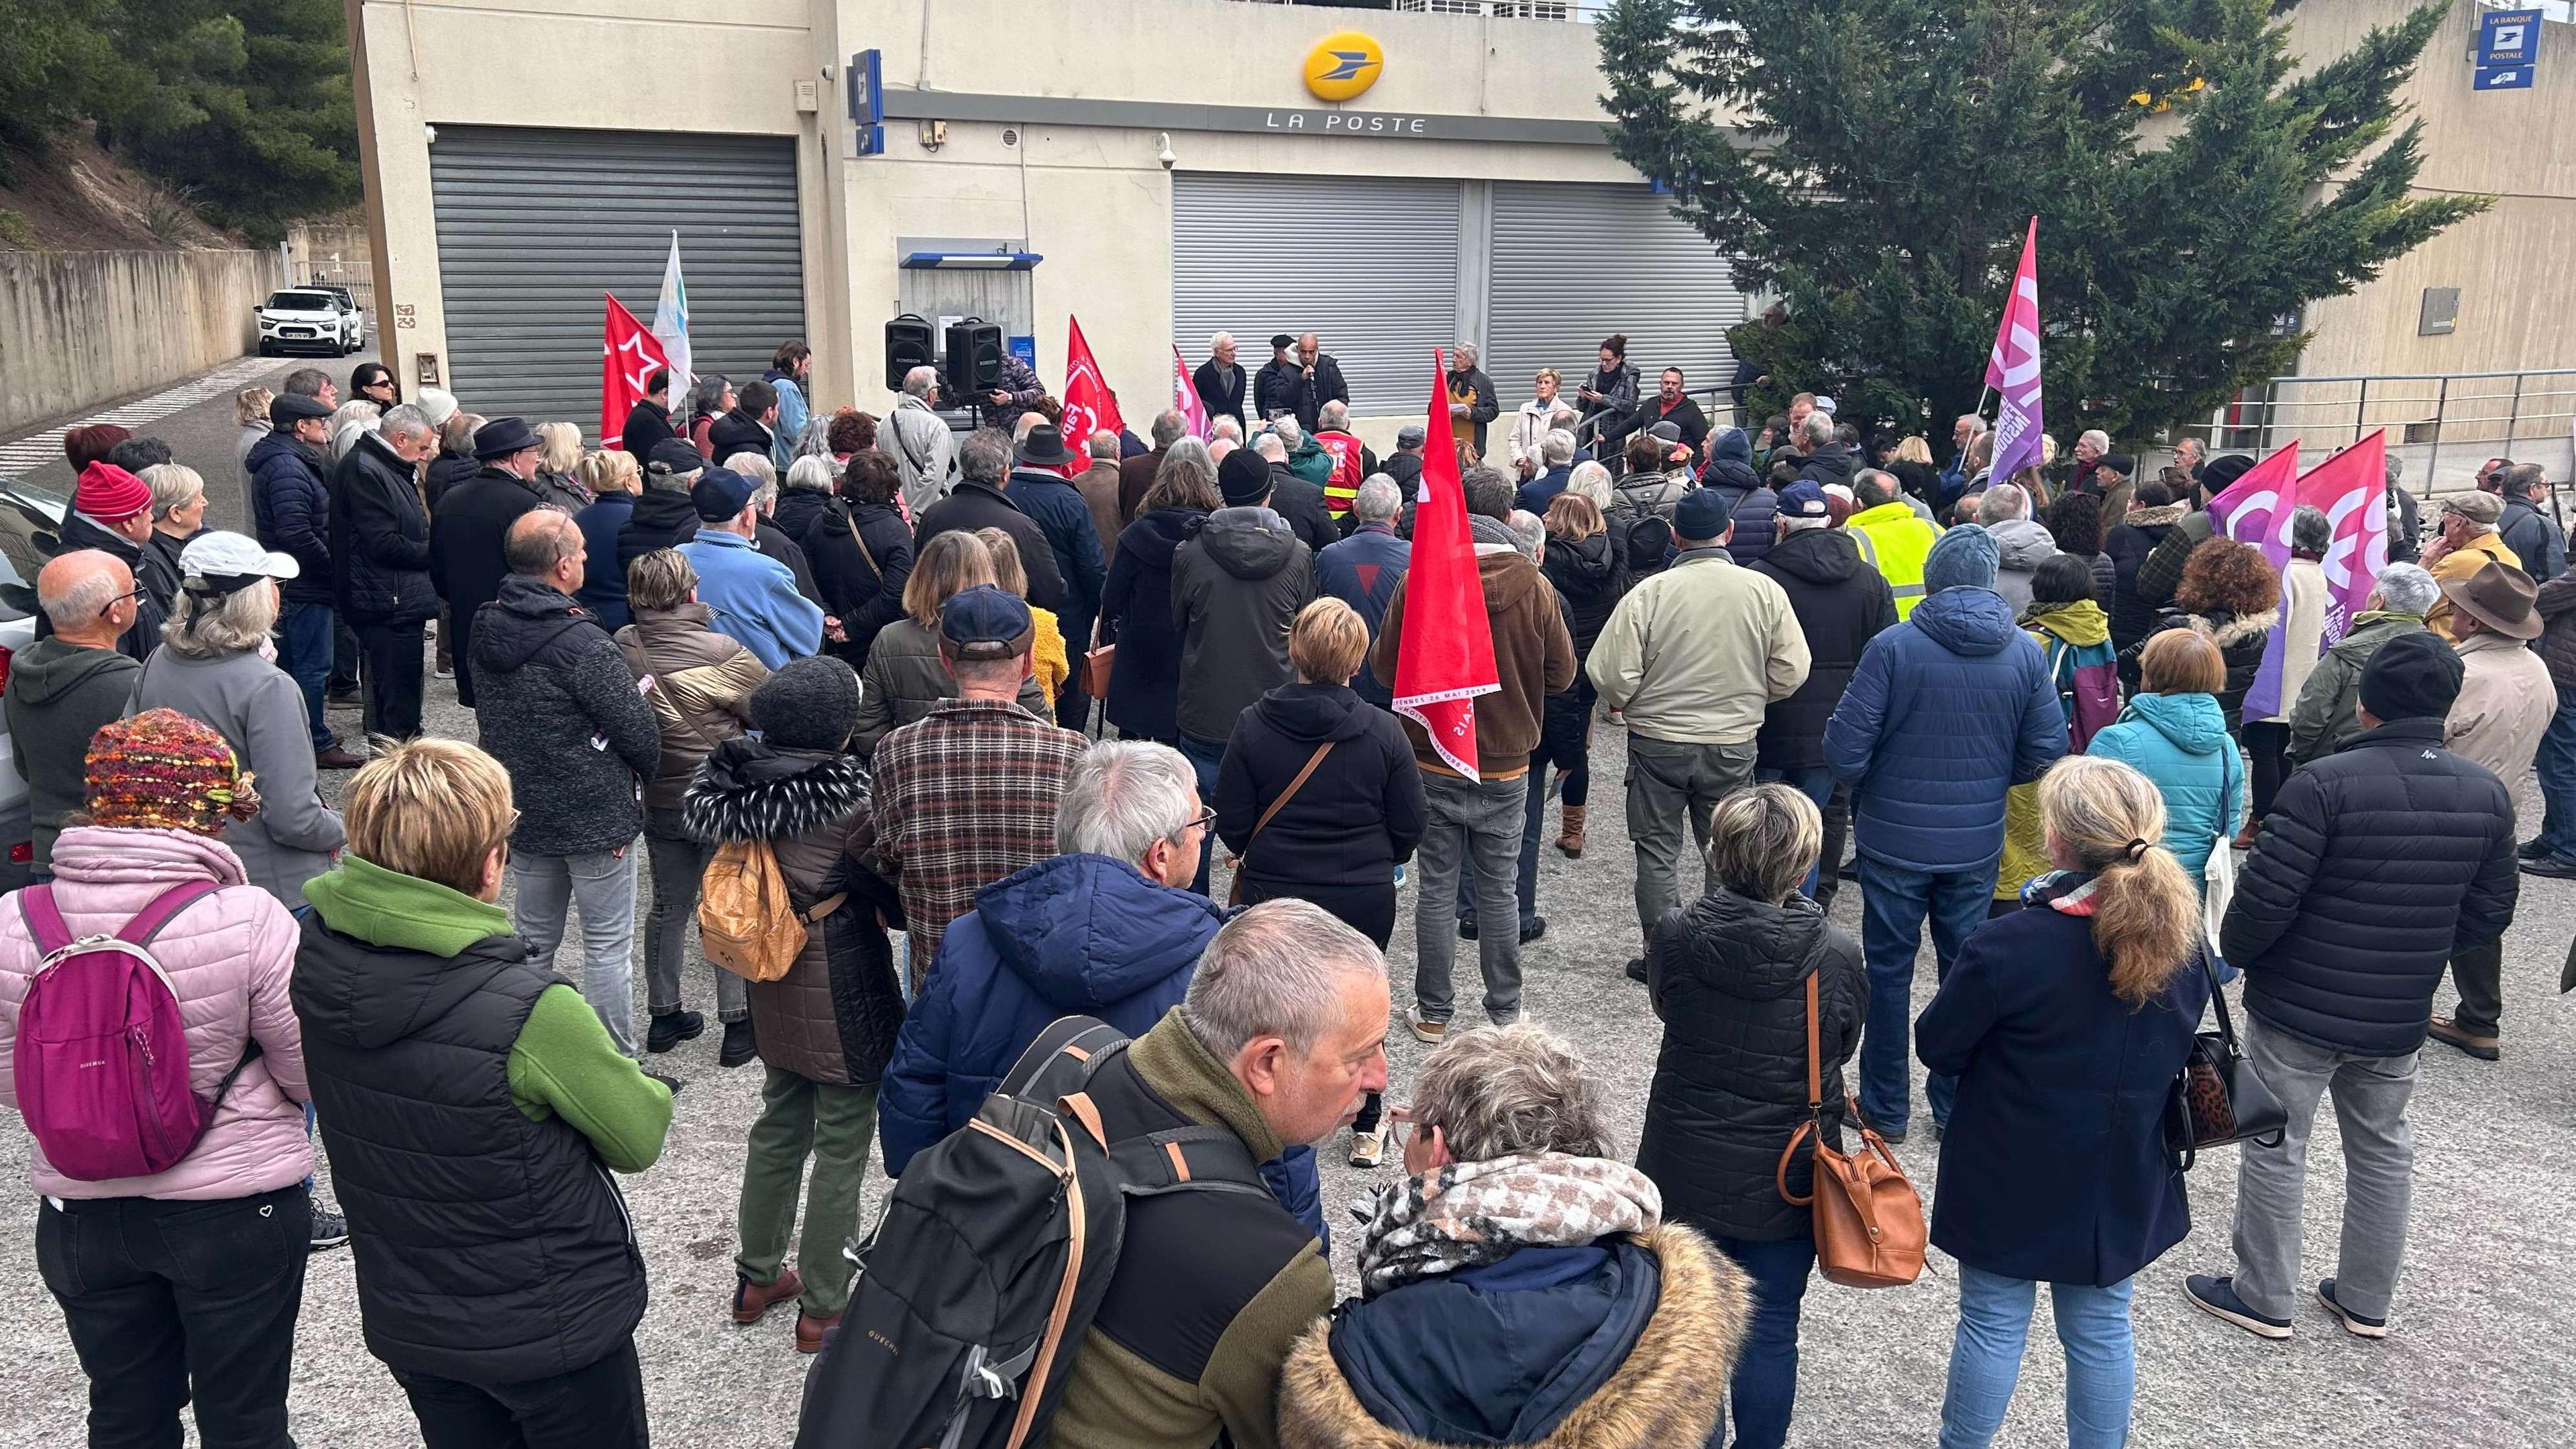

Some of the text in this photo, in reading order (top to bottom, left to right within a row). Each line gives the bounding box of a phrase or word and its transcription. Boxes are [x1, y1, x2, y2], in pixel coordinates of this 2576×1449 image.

[2500, 15, 2533, 24] BANQUE
[2489, 52, 2523, 60] POSTALE
[1267, 112, 1426, 133] LA POSTE
[1465, 688, 1487, 696] 2019
